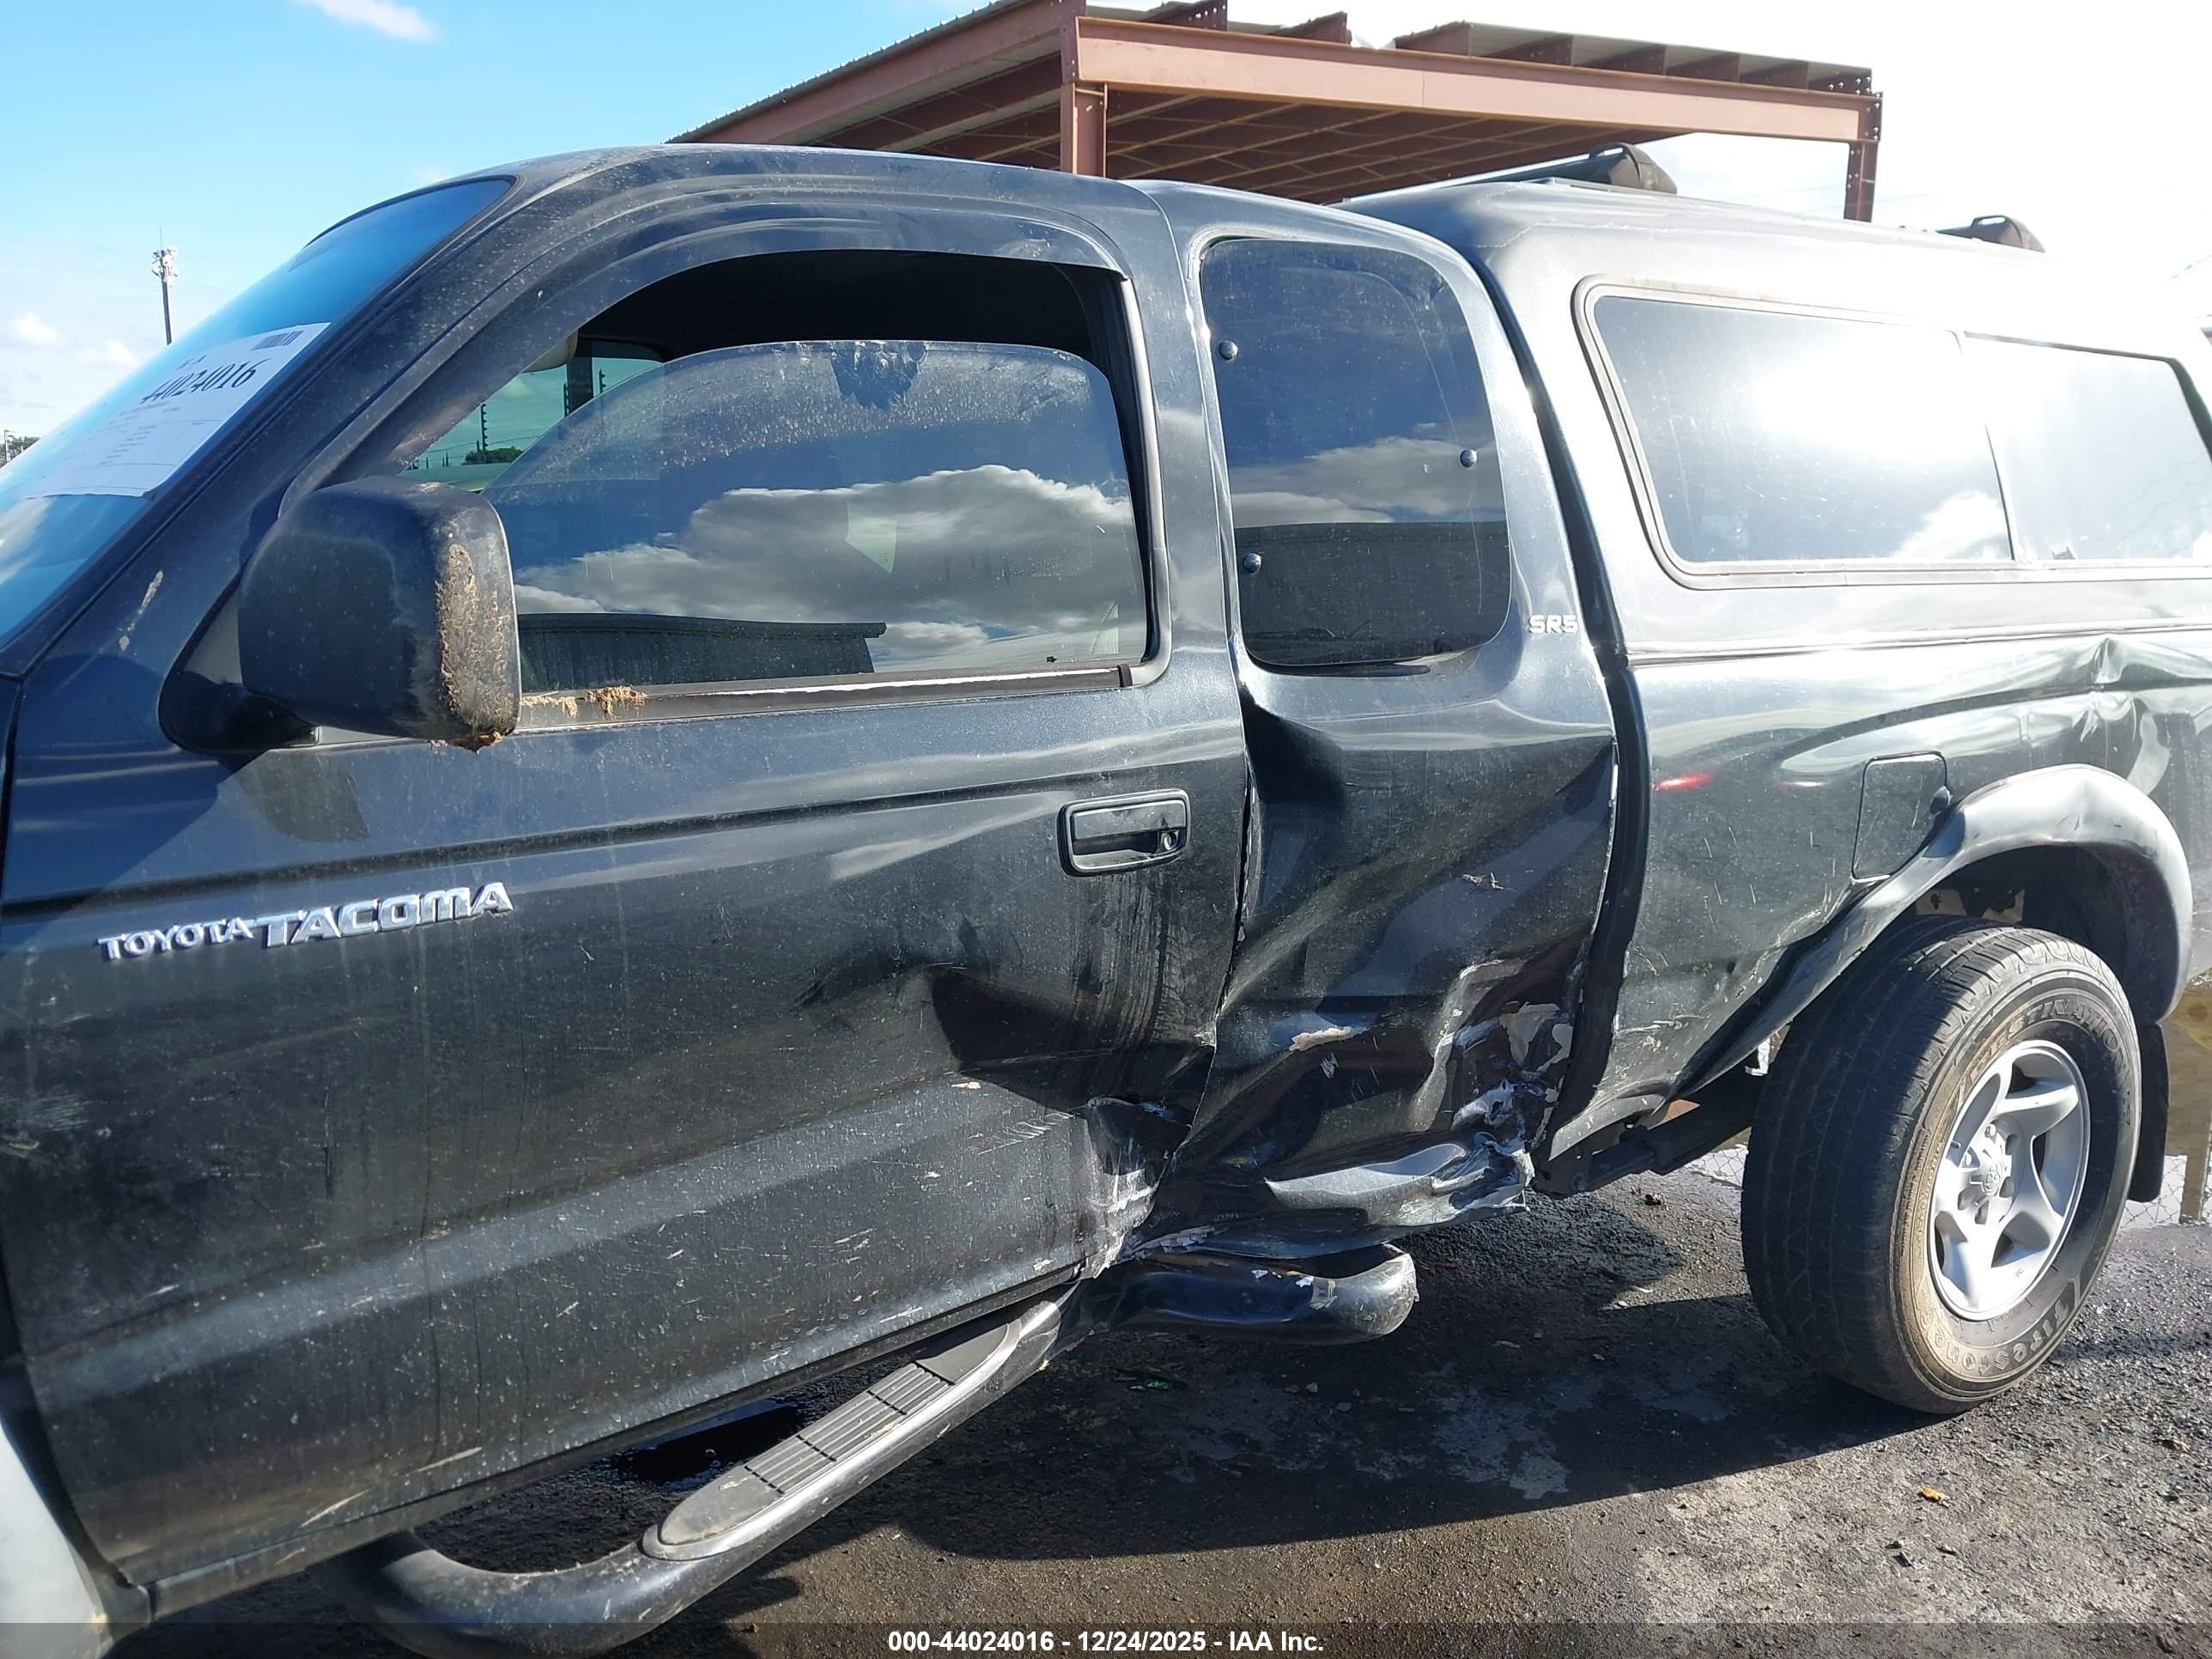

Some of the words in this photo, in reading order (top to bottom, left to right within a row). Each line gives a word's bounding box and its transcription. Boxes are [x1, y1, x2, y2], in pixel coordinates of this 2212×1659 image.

[1529, 614, 1578, 634] SR5
[98, 916, 253, 961] TOYOTA
[254, 882, 514, 947] TACOMA
